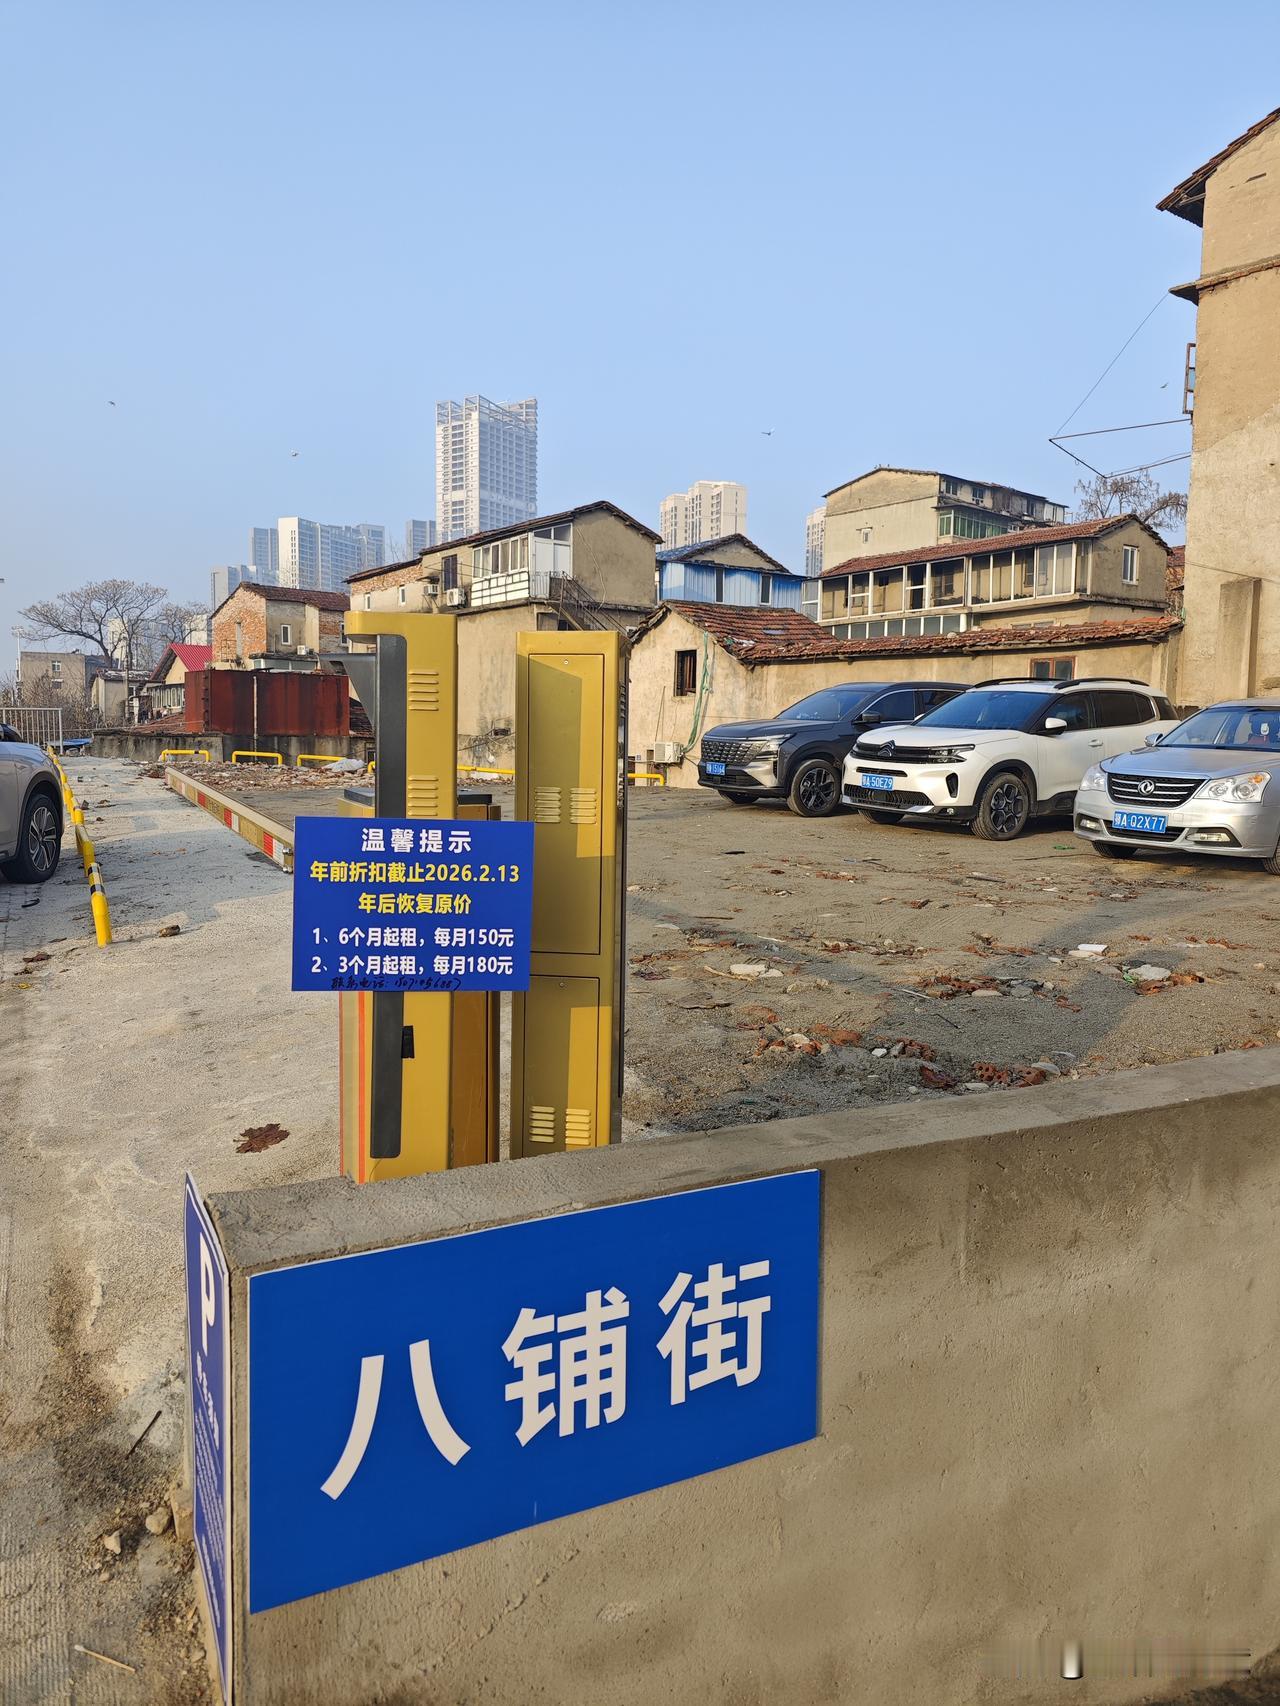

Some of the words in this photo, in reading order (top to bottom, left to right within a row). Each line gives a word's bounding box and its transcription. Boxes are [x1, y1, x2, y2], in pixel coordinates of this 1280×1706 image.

[361, 828, 472, 854] 温馨提示
[309, 860, 520, 884] 年前折扣截止2026.2.13
[357, 892, 472, 915] 年后恢复原价
[312, 926, 515, 948] 1、6个月起租，每月150元
[311, 955, 513, 975] 2、3个月起租，每月180元
[199, 1231, 216, 1357] P
[320, 1259, 772, 1500] 八铺街
